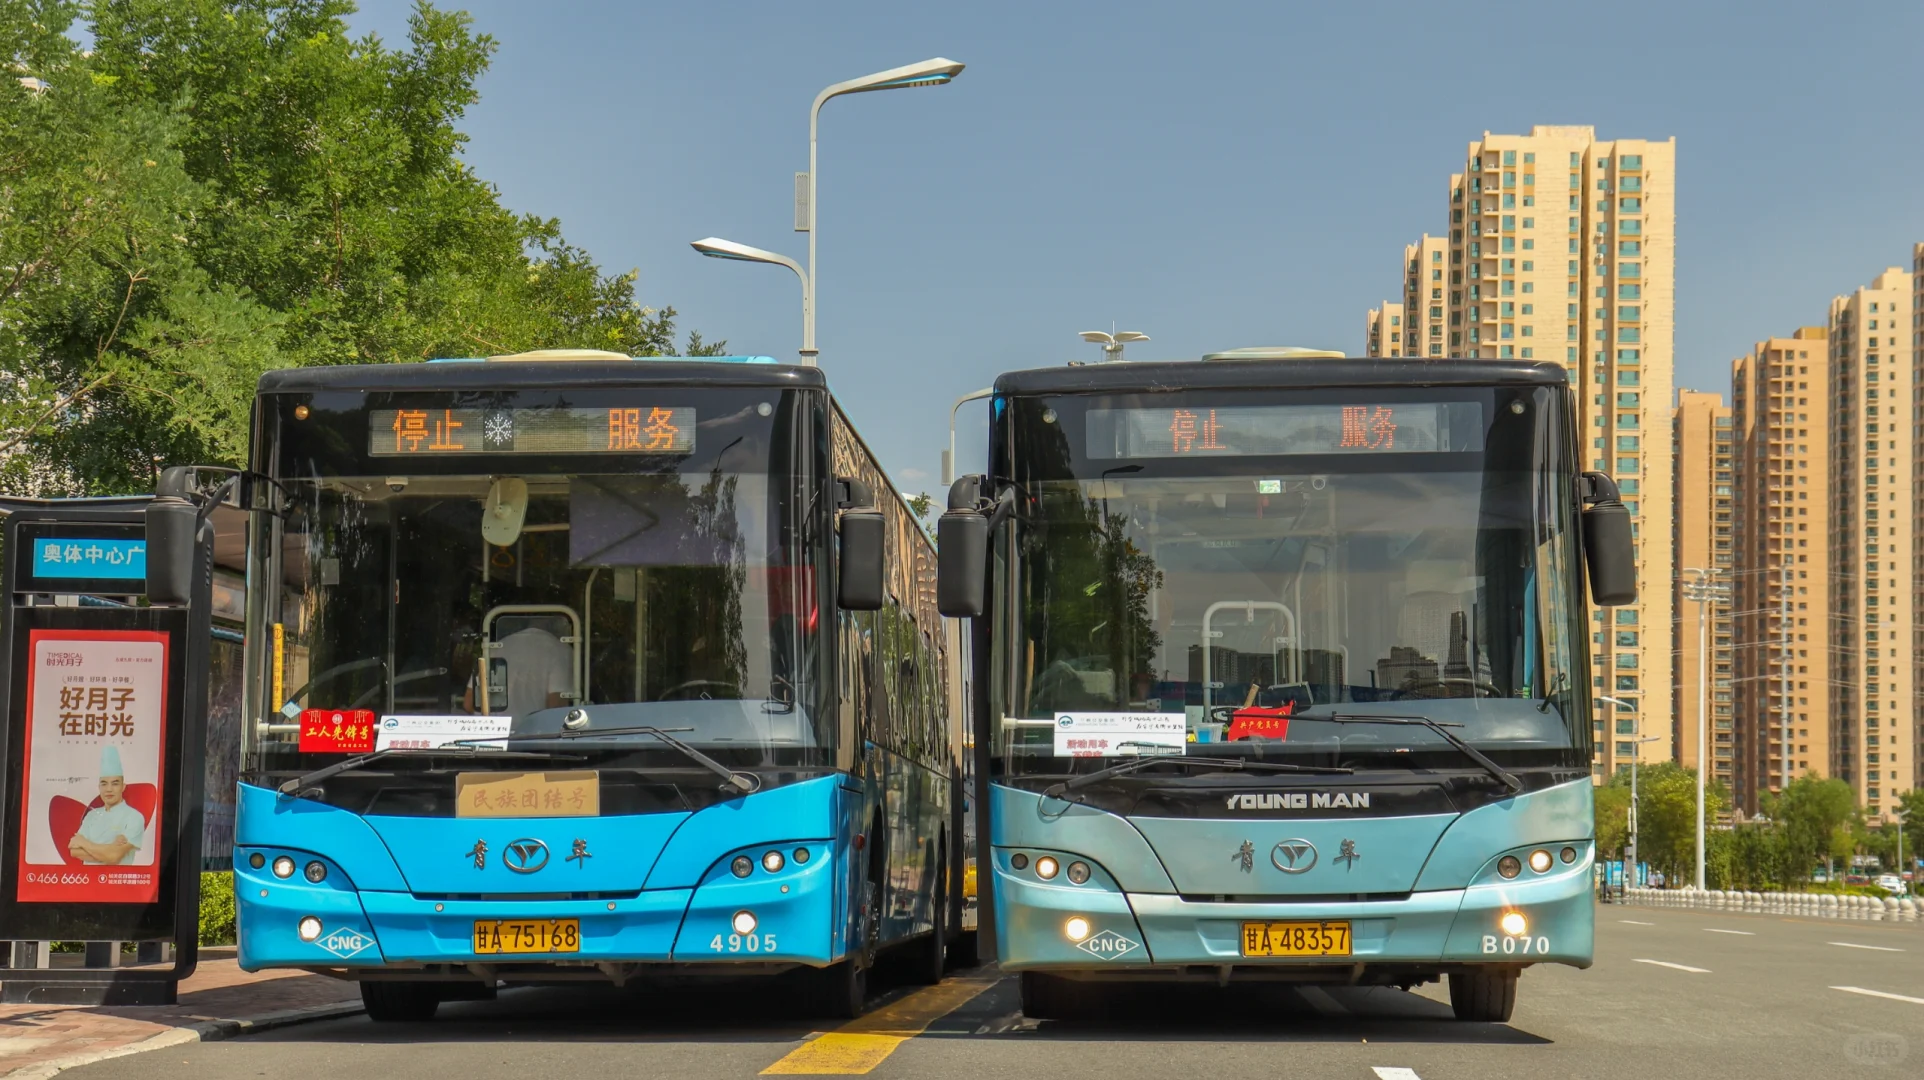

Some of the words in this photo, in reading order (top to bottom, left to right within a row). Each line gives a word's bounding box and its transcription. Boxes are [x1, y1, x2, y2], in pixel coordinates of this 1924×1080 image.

[391, 409, 464, 452] 停止
[607, 407, 679, 450] 服务
[1169, 409, 1227, 452] 停止
[1341, 406, 1397, 449] 服务
[43, 543, 145, 566] 奥体中心广
[46, 658, 83, 667] 时光月子
[59, 686, 136, 711] 好月子
[58, 712, 135, 737] 在时光
[305, 725, 369, 741] 工人先锋号
[1240, 720, 1280, 730] 共产党员号
[473, 786, 588, 811] 民族团结号
[1227, 793, 1308, 810] YOUNG
[1312, 793, 1370, 809] MAN
[37, 873, 59, 884] 466
[61, 873, 90, 885] 6666
[327, 937, 361, 950] CNG
[476, 924, 577, 949] 甘A·75168
[710, 934, 777, 953] 4905
[1089, 938, 1127, 951] CNG
[1246, 927, 1347, 951] 甘A·48357
[1482, 935, 1550, 955] B070
